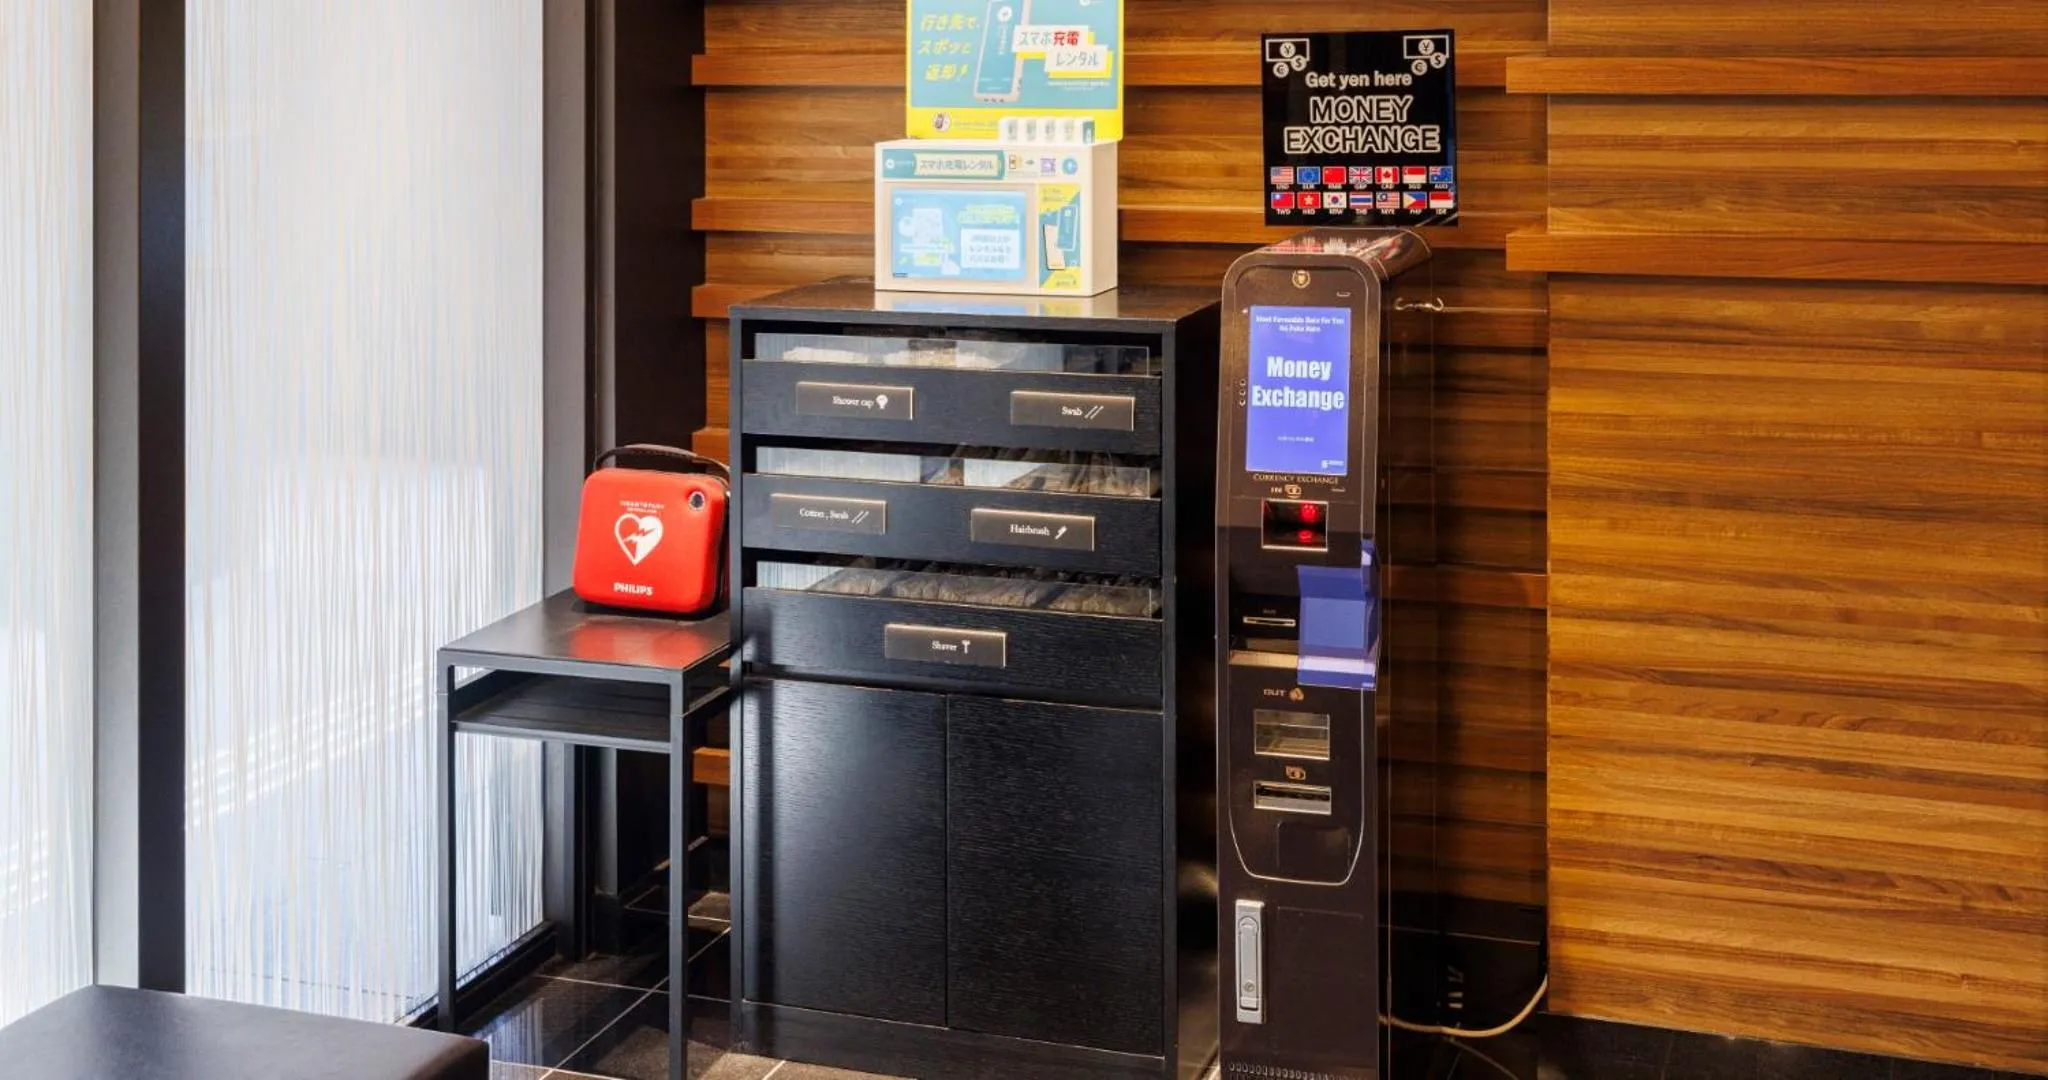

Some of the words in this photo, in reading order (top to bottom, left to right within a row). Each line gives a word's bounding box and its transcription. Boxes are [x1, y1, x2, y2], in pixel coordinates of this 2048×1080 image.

[1055, 52, 1099, 66] レンタル
[1305, 72, 1336, 88] Get
[1338, 74, 1370, 90] yen
[1374, 70, 1412, 87] here
[1309, 95, 1413, 124] MONEY
[1284, 125, 1441, 154] EXCHANGE
[1266, 356, 1332, 381] Money
[1251, 385, 1345, 411] Exchange
[1061, 406, 1083, 416] Swab
[1253, 474, 1296, 483] CURRENCY
[1296, 475, 1339, 485] EXCHANGE
[1010, 523, 1050, 536] Hairbrush
[613, 582, 653, 596] PHILIPS
[1264, 688, 1286, 697] OUT
